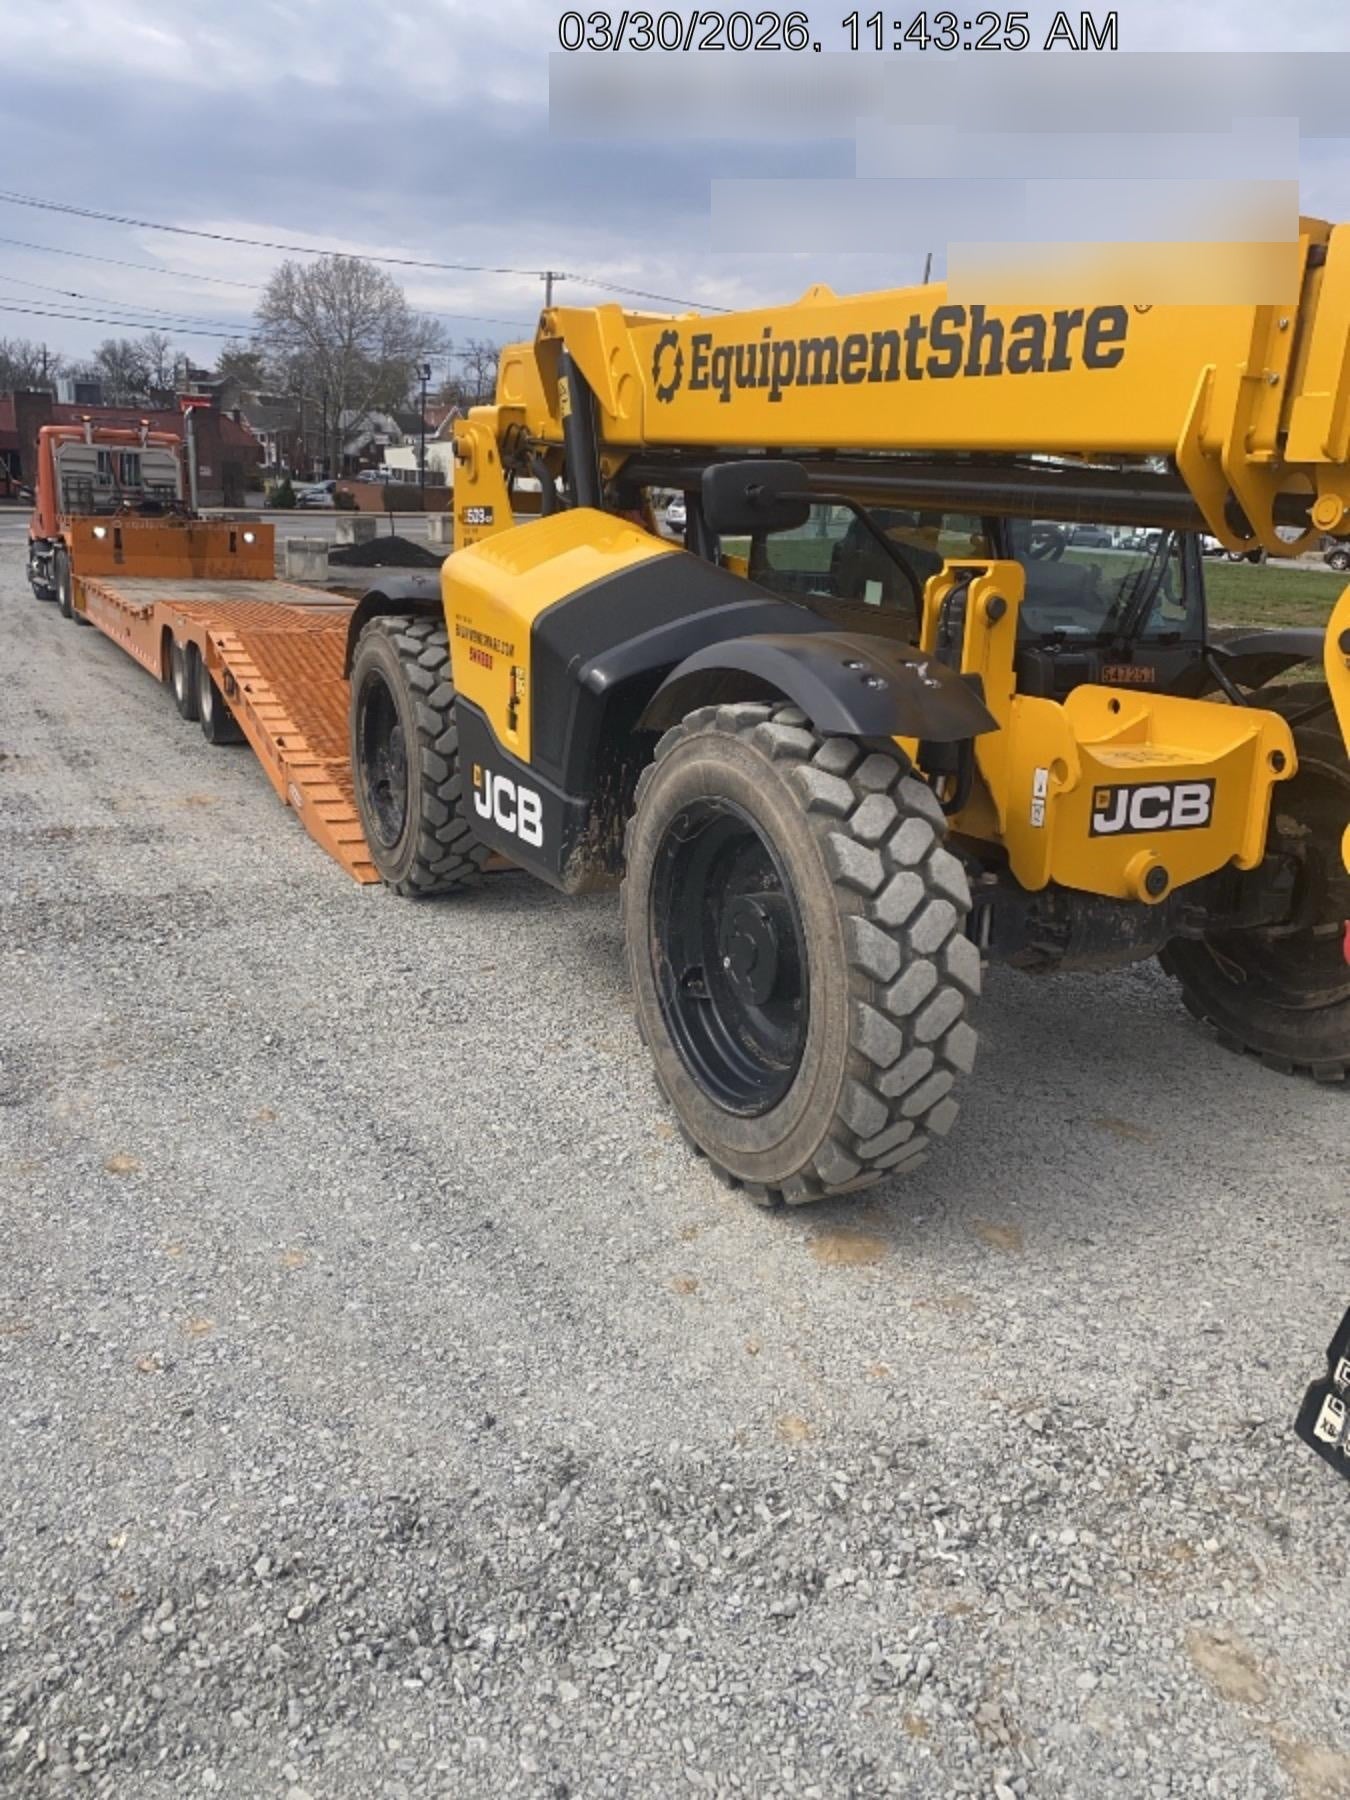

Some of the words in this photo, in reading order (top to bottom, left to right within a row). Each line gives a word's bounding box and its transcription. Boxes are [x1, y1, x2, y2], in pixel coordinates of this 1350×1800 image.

[688, 304, 1128, 403] EquipmentShare
[473, 768, 543, 848] JCB
[1093, 783, 1211, 833] JCB
